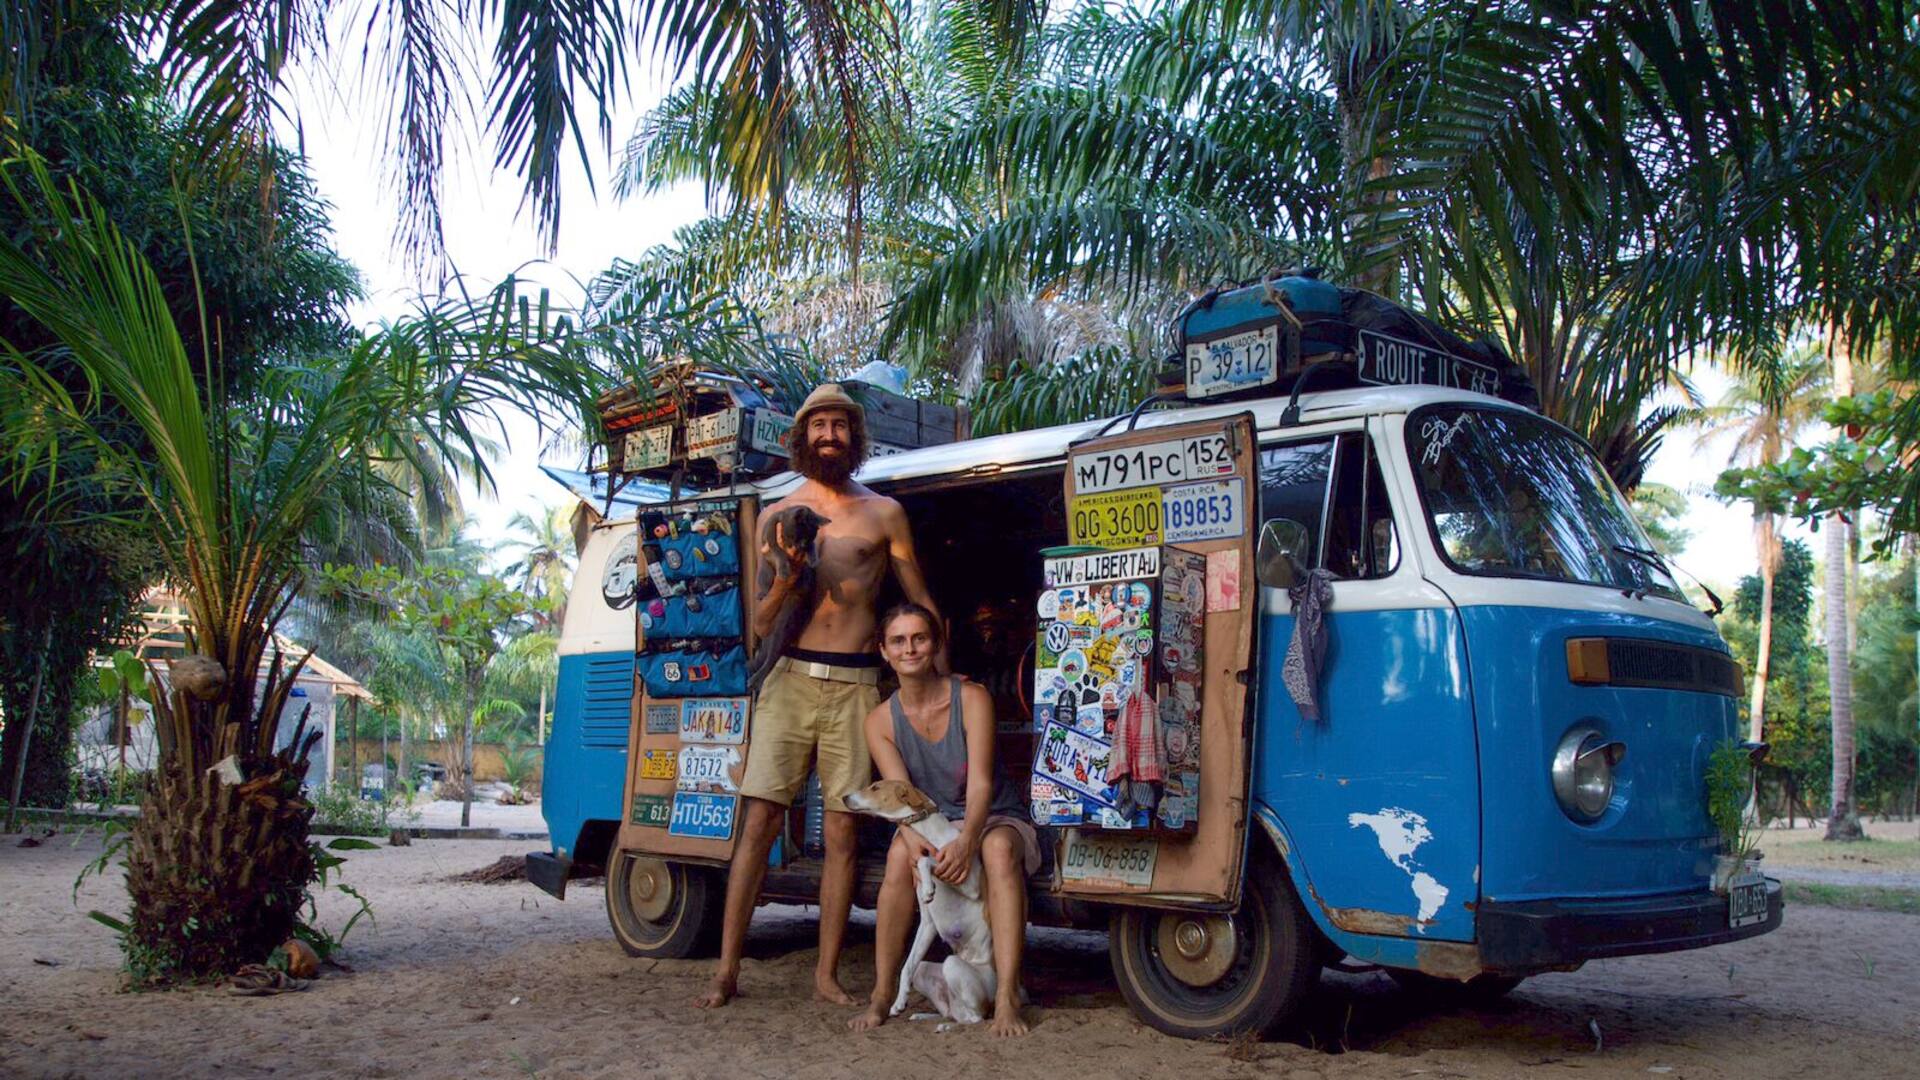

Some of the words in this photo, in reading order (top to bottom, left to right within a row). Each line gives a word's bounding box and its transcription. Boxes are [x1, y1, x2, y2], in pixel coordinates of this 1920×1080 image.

[1190, 357, 1202, 385] P
[1213, 351, 1233, 380] 39
[1246, 341, 1272, 374] 121
[1375, 341, 1427, 384] ROUTE
[1187, 438, 1227, 466] 152
[1197, 464, 1217, 474] RUS
[1173, 488, 1195, 498] COSTA
[1075, 510, 1100, 539] QG
[1107, 502, 1159, 536] 3600
[1162, 494, 1232, 530] 189853
[1056, 561, 1074, 583] VW
[1085, 552, 1157, 581] LIBERTAD
[667, 668, 679, 678] 66
[718, 711, 742, 733] 148
[686, 758, 722, 777] 87572
[650, 804, 670, 821] 613
[672, 803, 731, 827] HTU563
